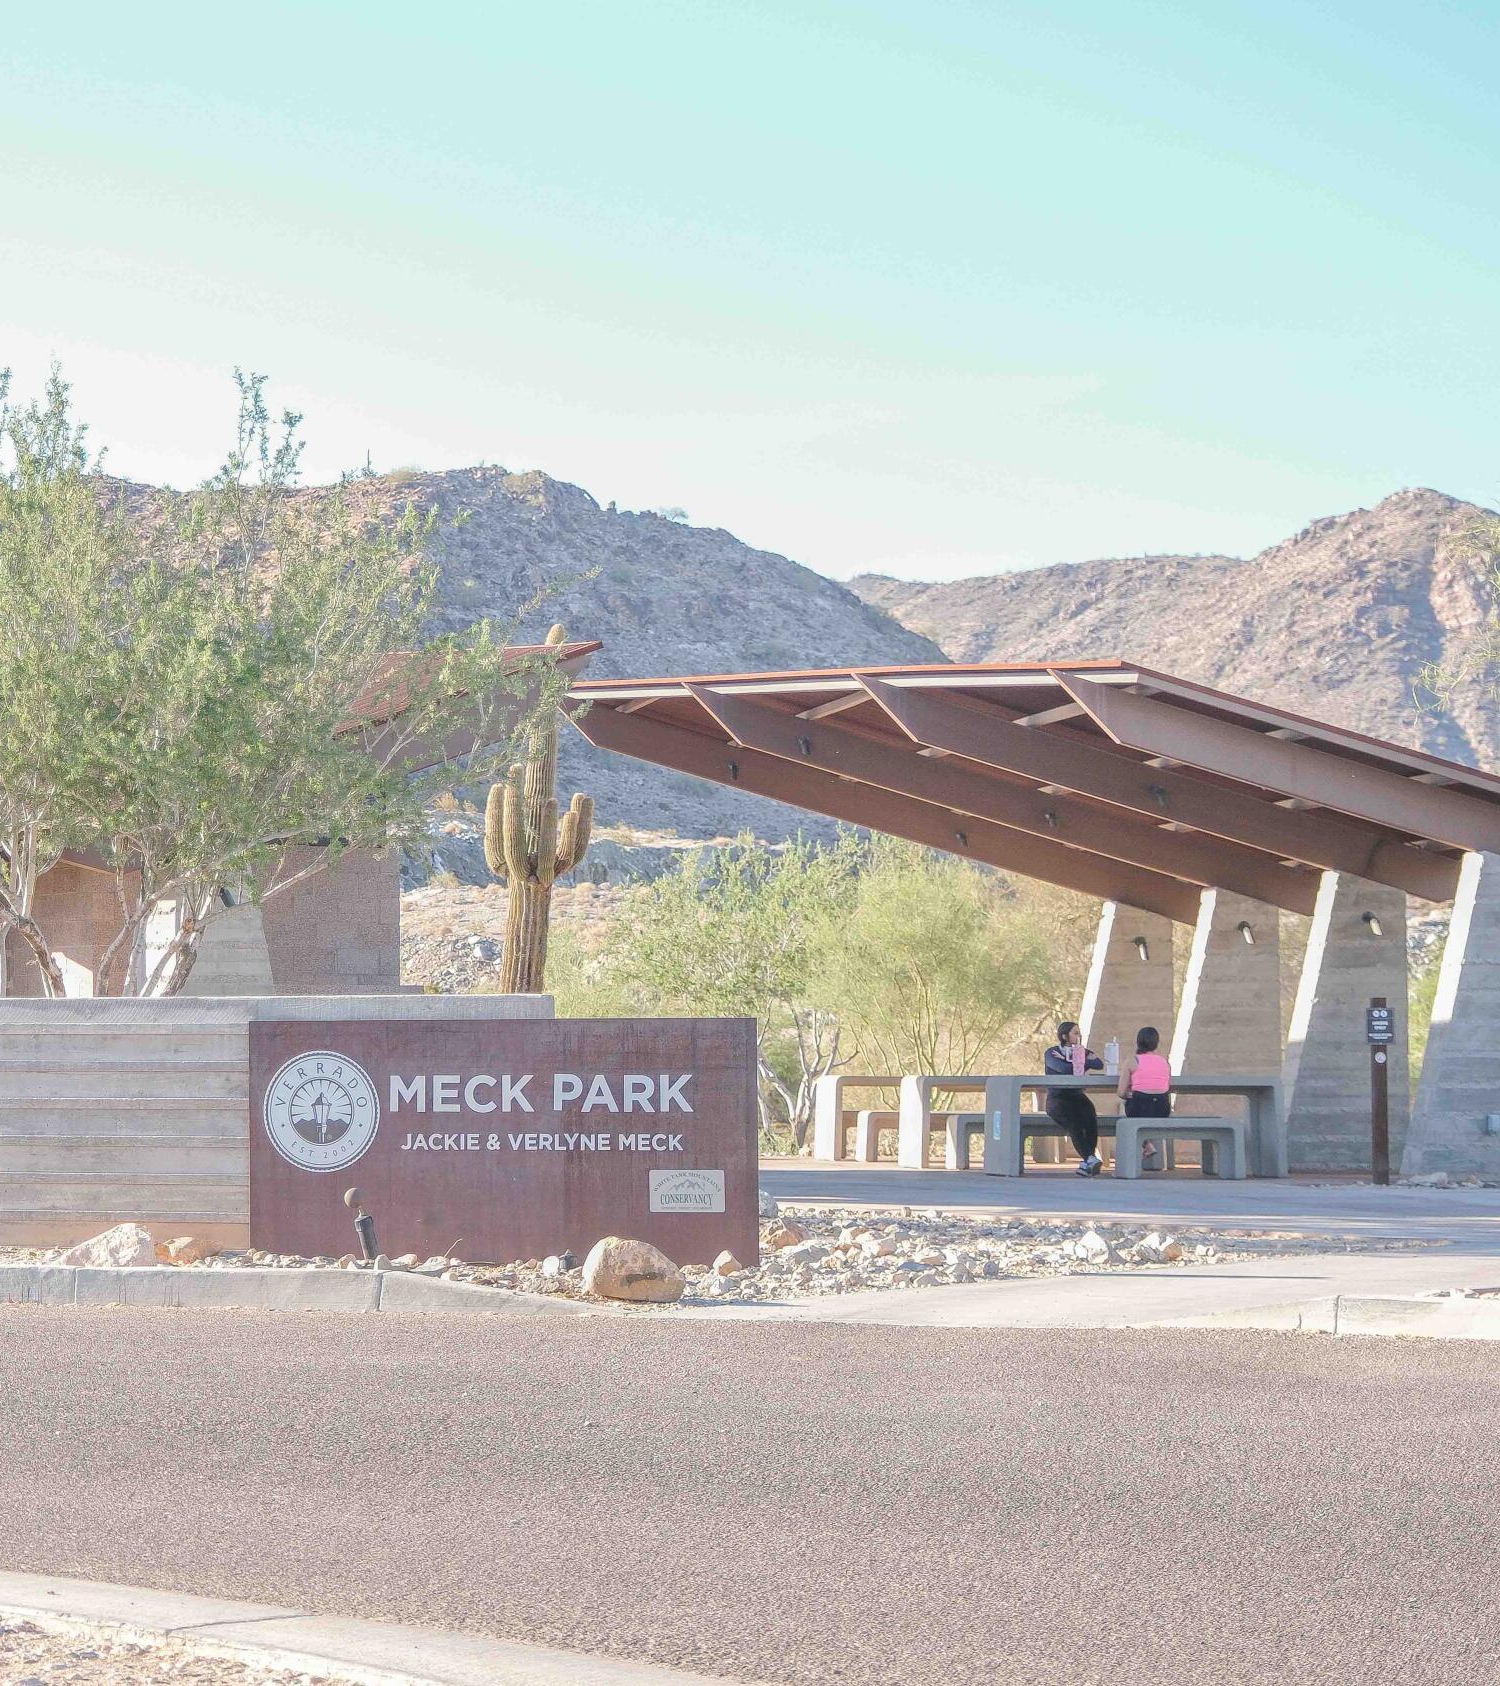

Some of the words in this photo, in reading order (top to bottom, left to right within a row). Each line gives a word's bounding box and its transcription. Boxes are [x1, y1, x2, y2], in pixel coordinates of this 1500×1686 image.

[275, 1062, 367, 1107] VERRADO
[389, 1074, 535, 1113] MECK
[553, 1073, 694, 1113] PARK
[323, 1139, 354, 1158] 2002
[401, 1133, 479, 1151] JACKIE
[486, 1133, 501, 1151] &
[508, 1133, 611, 1151] VERLYNE
[618, 1133, 683, 1151] MECK
[660, 1193, 713, 1205] CONSERVANCY
